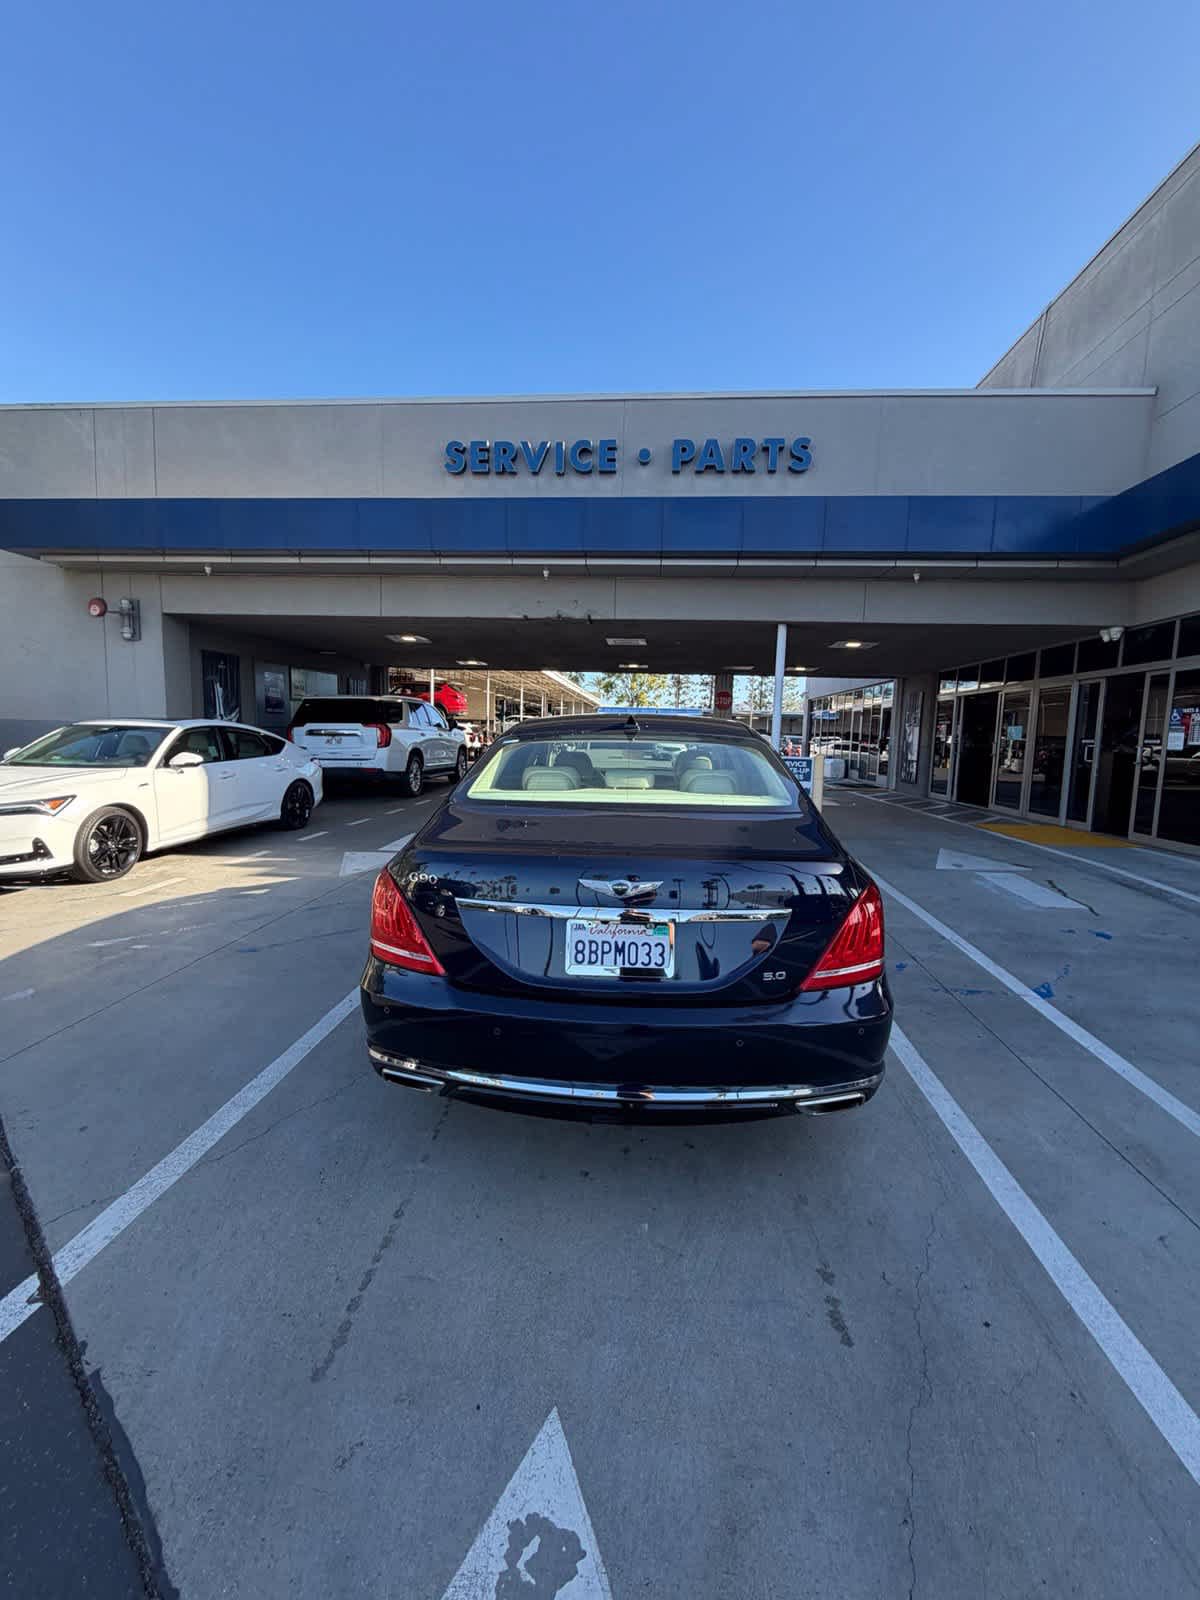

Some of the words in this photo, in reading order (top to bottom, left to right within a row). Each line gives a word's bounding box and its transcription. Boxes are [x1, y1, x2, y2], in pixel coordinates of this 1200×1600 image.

[444, 439, 617, 475] SERVICE
[671, 437, 814, 474] PARTS
[409, 871, 438, 885] G90
[590, 924, 648, 939] California
[574, 940, 665, 967] 8BPM033
[763, 971, 787, 981] 5.0
